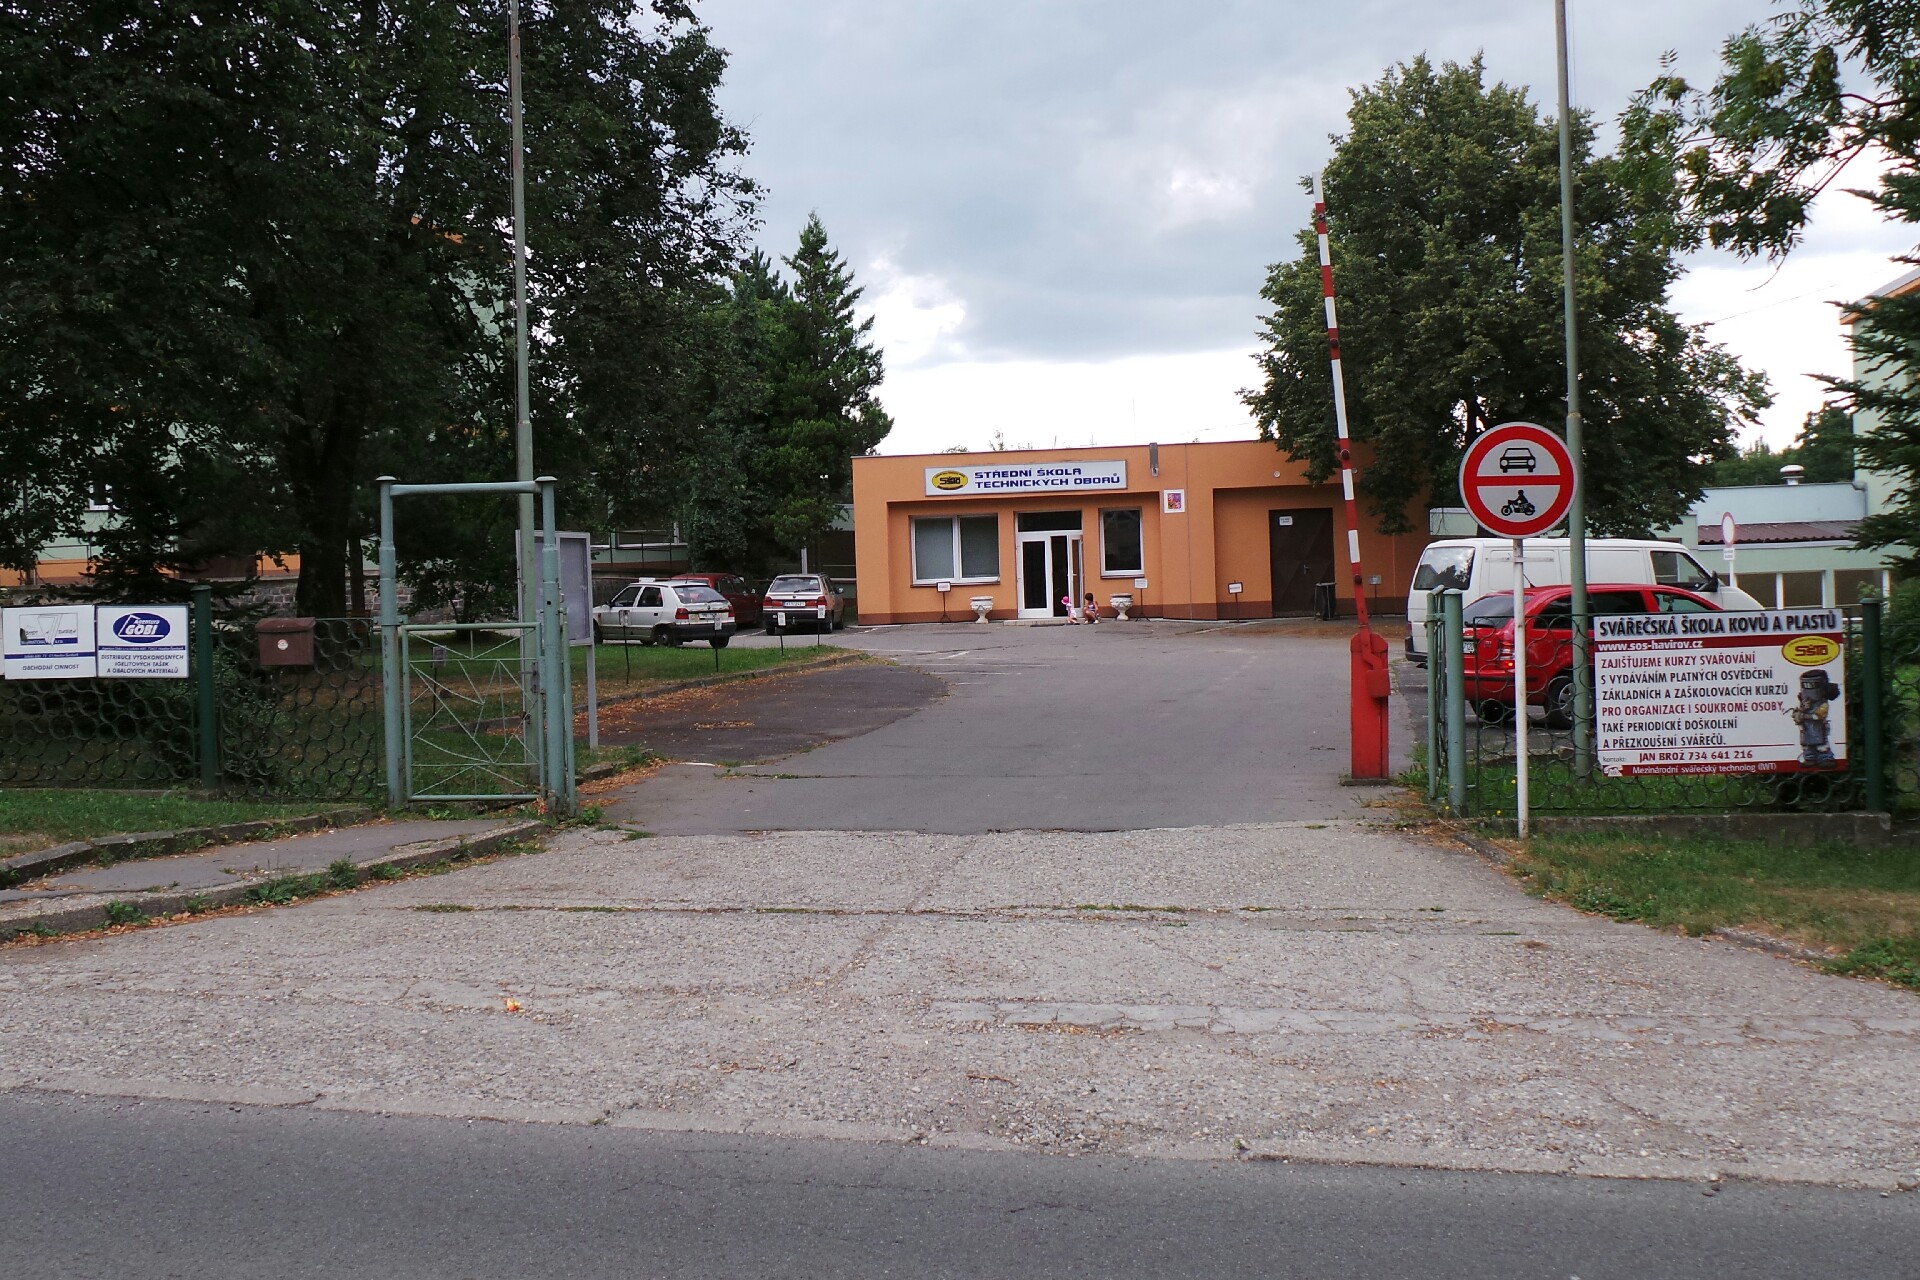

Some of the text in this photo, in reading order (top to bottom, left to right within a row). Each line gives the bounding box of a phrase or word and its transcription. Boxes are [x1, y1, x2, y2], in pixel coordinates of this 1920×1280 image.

[974, 468, 1032, 479] STŘEDNÍ
[1036, 467, 1082, 477] ŠKOLA
[975, 477, 1069, 489] TECHNICKÝCH
[1073, 473, 1120, 485] OBORŮ
[125, 625, 158, 635] GOBI
[1599, 610, 1836, 636] SVÁŘEČSKÁ ŠKOLA KOVŮ A PLASTŮ
[1601, 651, 1755, 669] ZAJIŠŤUJEME KURZY SVAŘOVÁNÍ
[1601, 666, 1773, 685] S VYDÁVÁNÍM PLATNÝCH OSVĚDČENÍ
[1602, 682, 1788, 700] ZÁKLADNÍCH A ZAŠKOLOVACÍCH KURZŮ
[1602, 706, 1621, 716] PRO
[1625, 704, 1685, 716] ORGANIZACE
[1688, 704, 1691, 713] I
[1694, 700, 1748, 713] SOUKROMÉ
[1602, 716, 1738, 732] TAKÉ PERIODICKÉ DOŠKOLENÍ
[1603, 733, 1726, 748] A PŘEZKOUŠENÍ SVÁŘEČŮ.
[1639, 753, 1655, 763] JAN
[1659, 750, 1685, 761] BROŽ
[1688, 752, 1707, 760] 734
[1734, 750, 1753, 759] 216
[1632, 765, 1678, 774] Mezinárodní
[1681, 764, 1717, 774] svářečský
[1719, 764, 1756, 773] technolog
